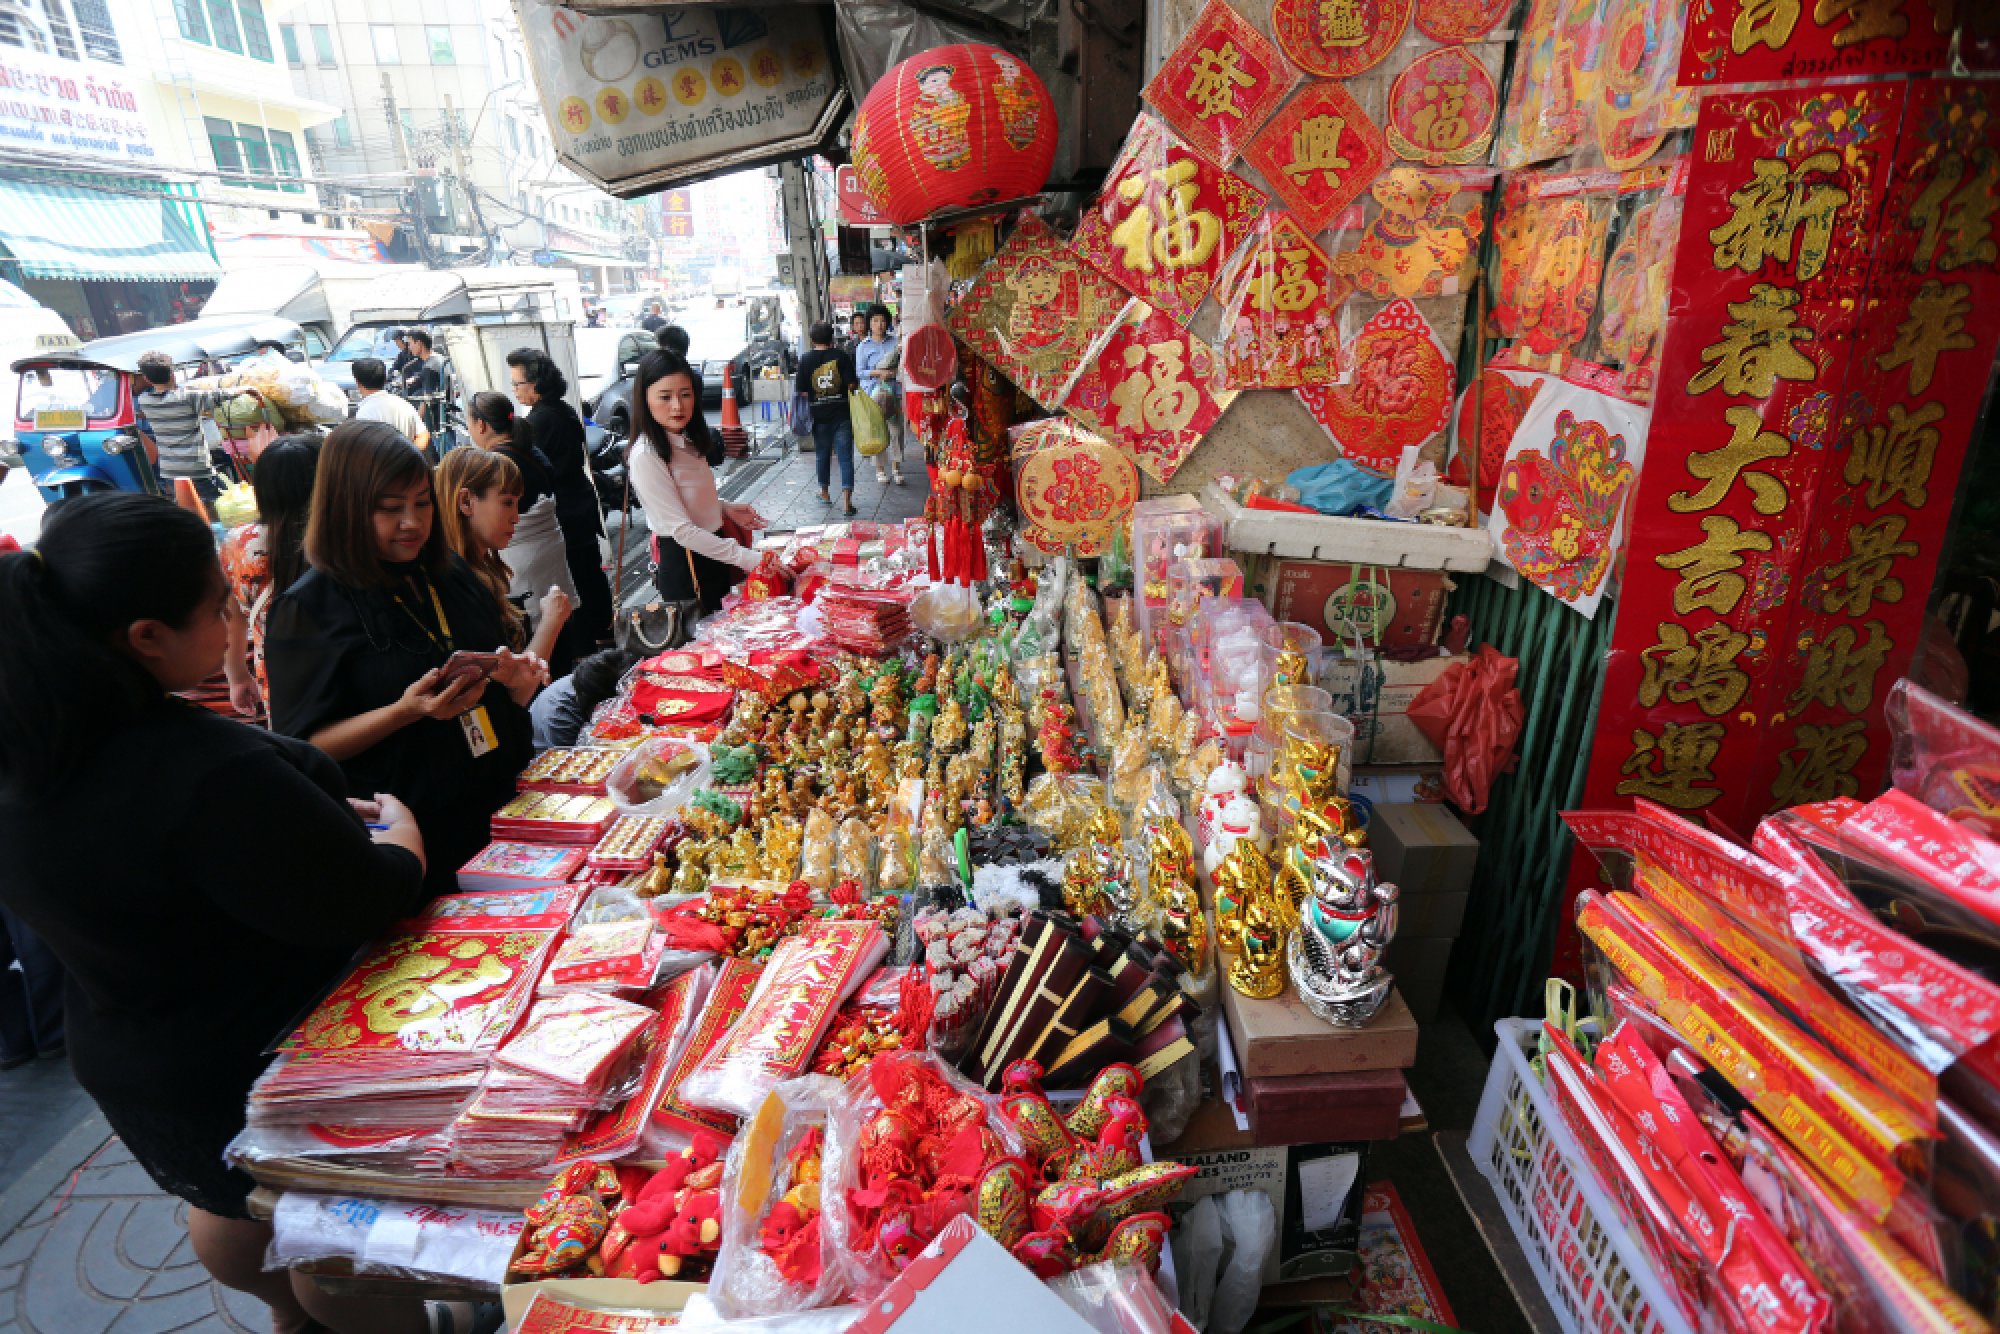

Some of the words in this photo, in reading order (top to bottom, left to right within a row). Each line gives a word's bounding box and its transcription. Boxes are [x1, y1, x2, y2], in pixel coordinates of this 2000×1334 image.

[643, 37, 717, 69] GEMS
[1186, 40, 1257, 121] 發
[1282, 114, 1350, 188] 興
[1411, 84, 1469, 153] 福
[667, 191, 688, 235] 金行
[1111, 157, 1222, 275] 福
[1248, 248, 1320, 316] 福
[37, 335, 71, 347] TAXI
[1351, 334, 1425, 415] 福
[1109, 339, 1201, 436] 福
[1043, 451, 1115, 524] 福
[1615, 150, 1849, 827] 新春大吉鴻運
[1551, 513, 1584, 562] 福
